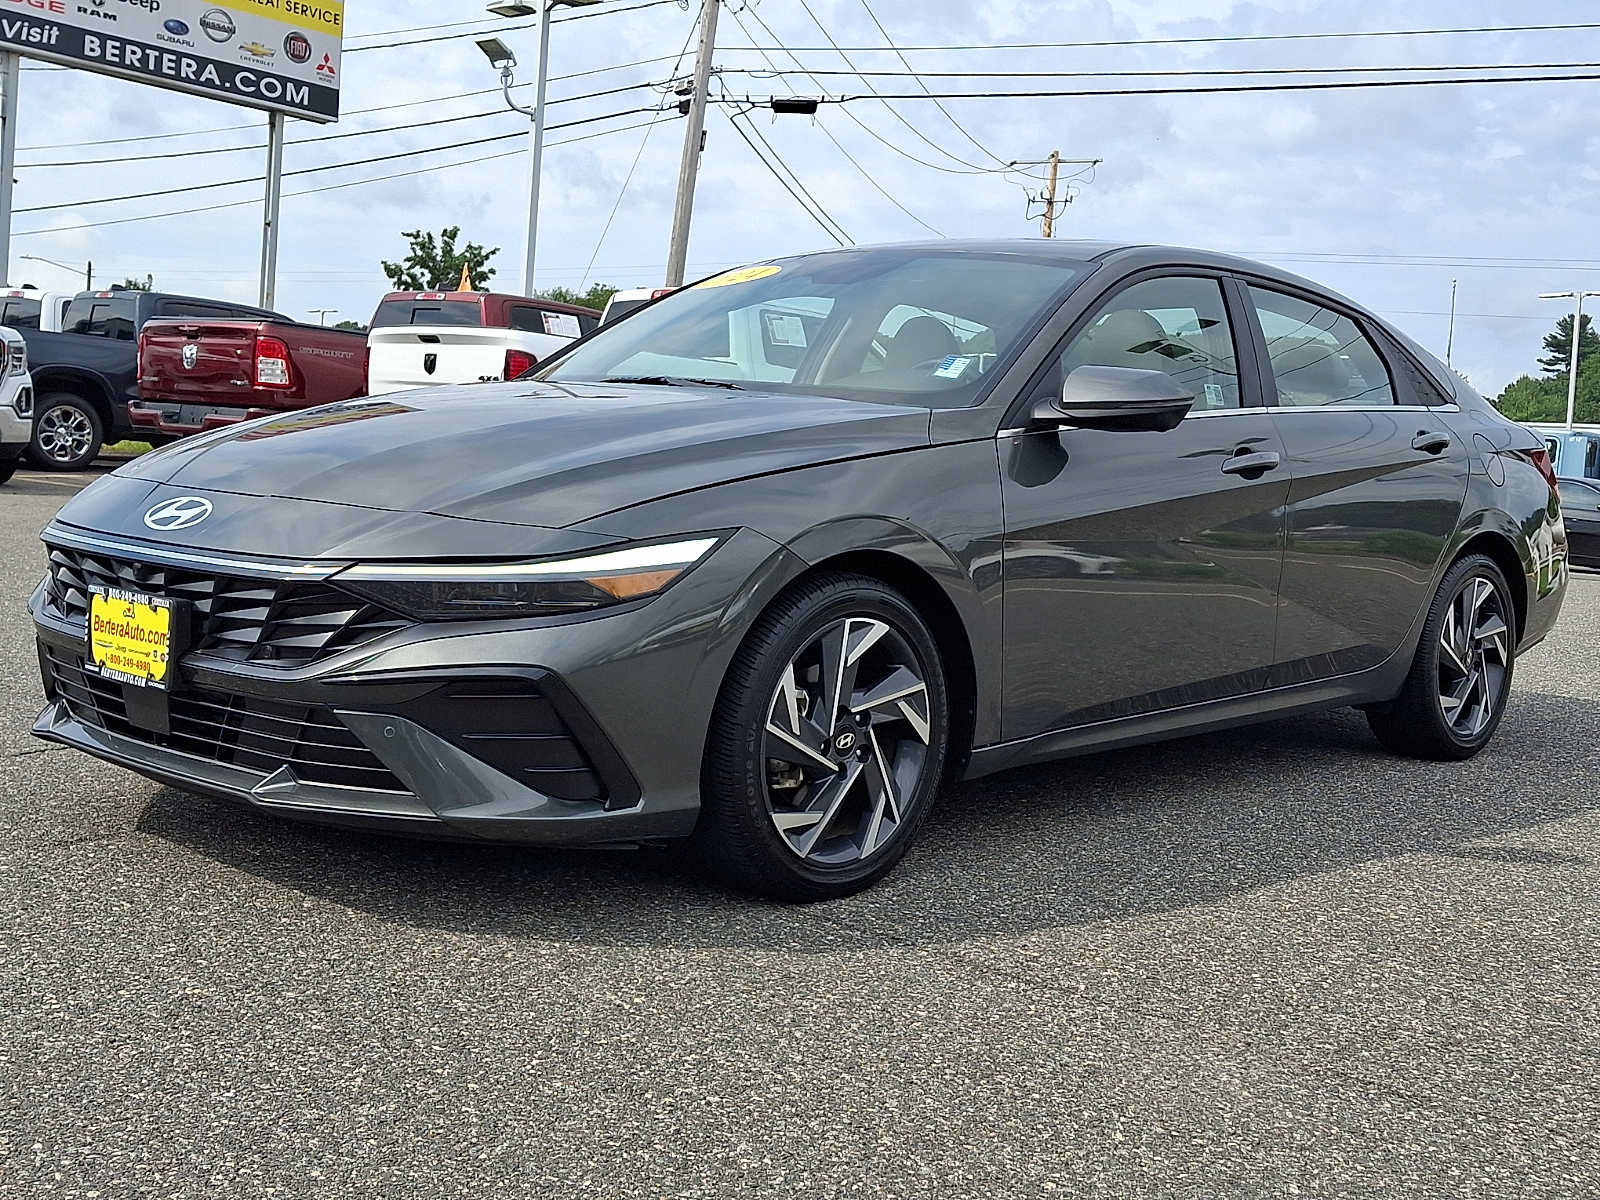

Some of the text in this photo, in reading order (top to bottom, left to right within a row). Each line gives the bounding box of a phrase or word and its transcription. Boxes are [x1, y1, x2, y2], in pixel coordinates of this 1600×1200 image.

[77, 6, 118, 21] RAM
[118, 0, 160, 13] eep
[285, 0, 341, 25] SERVICE
[202, 18, 234, 33] NISSAN
[156, 33, 195, 48] SUBARU
[291, 39, 307, 57] FIAT
[1, 18, 310, 106] Visit BERTERA.COM
[240, 55, 274, 68] CHEVROLET
[94, 614, 168, 647] BerteraAuto.com
[105, 652, 151, 673] 1-800-249-4980
